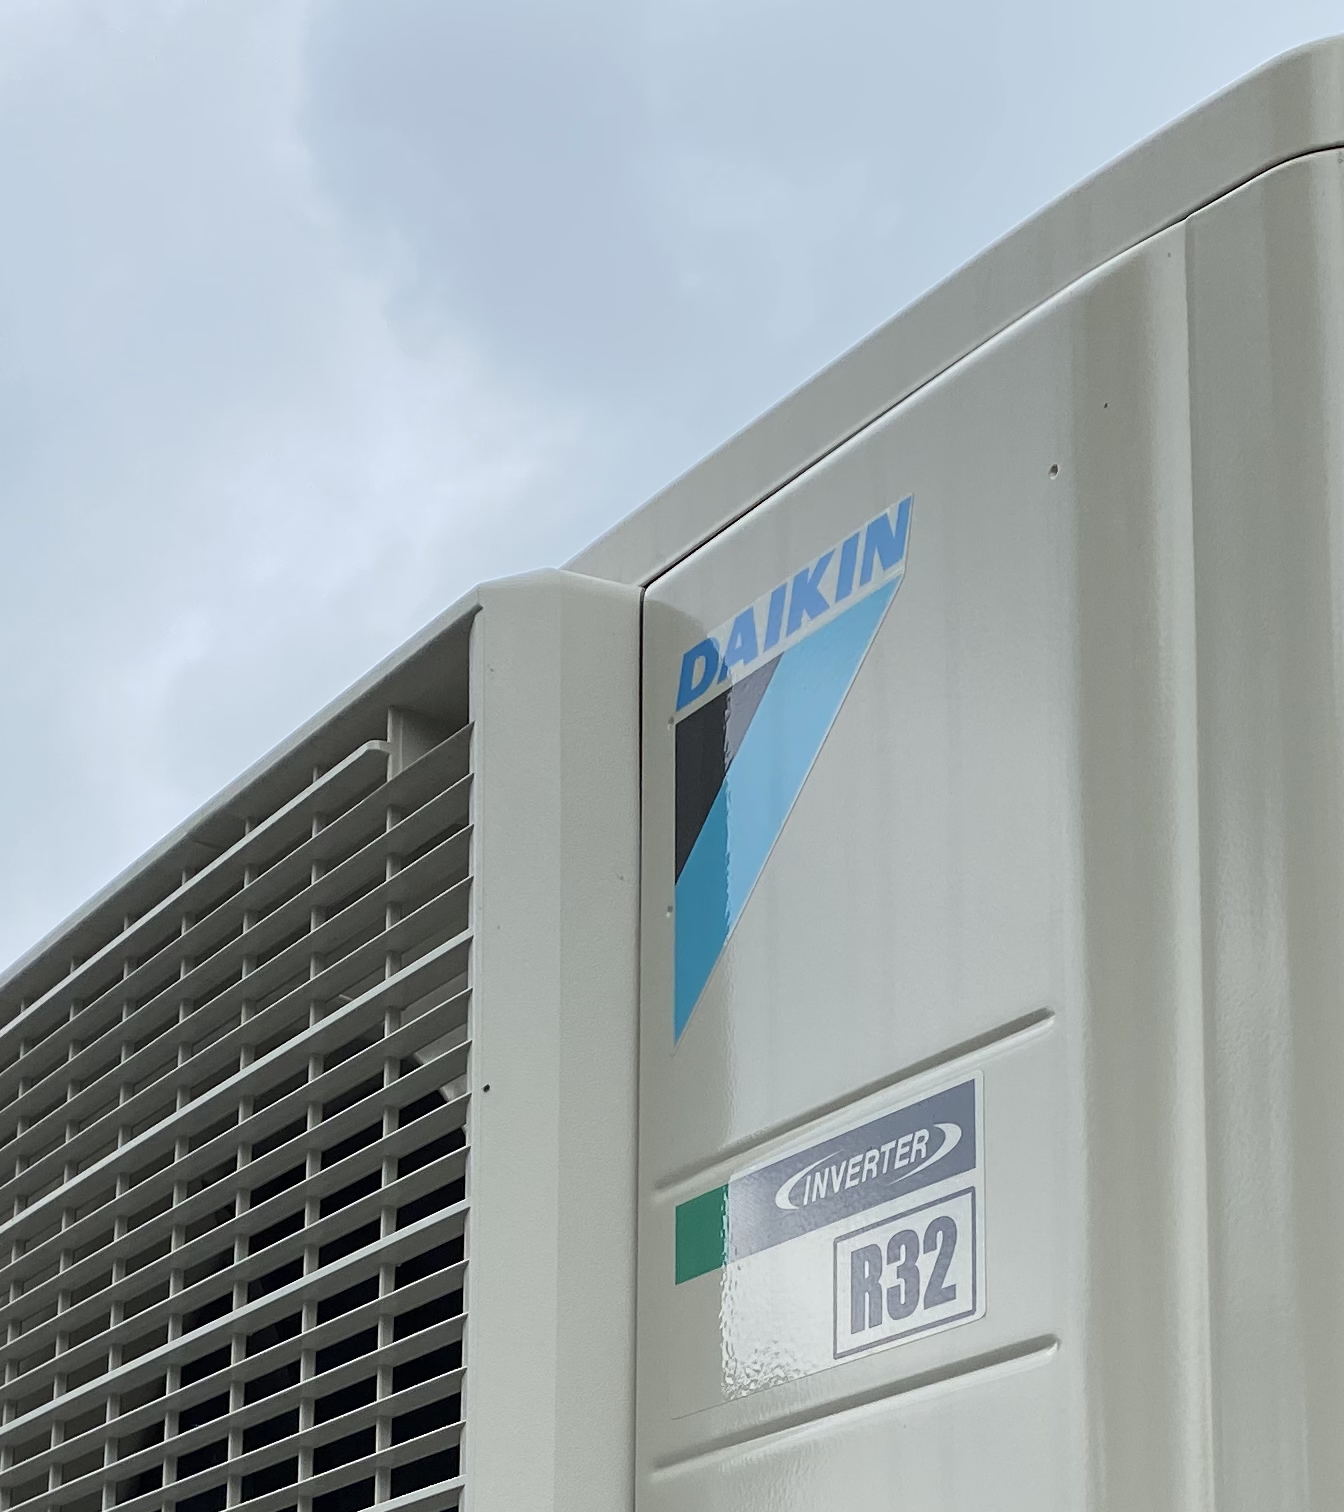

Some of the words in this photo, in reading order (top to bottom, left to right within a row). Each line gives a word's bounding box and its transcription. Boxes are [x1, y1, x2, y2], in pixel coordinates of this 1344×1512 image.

[676, 495, 912, 712] DAIKIN
[803, 1128, 931, 1208] INVERTER
[850, 1215, 957, 1335] R32
